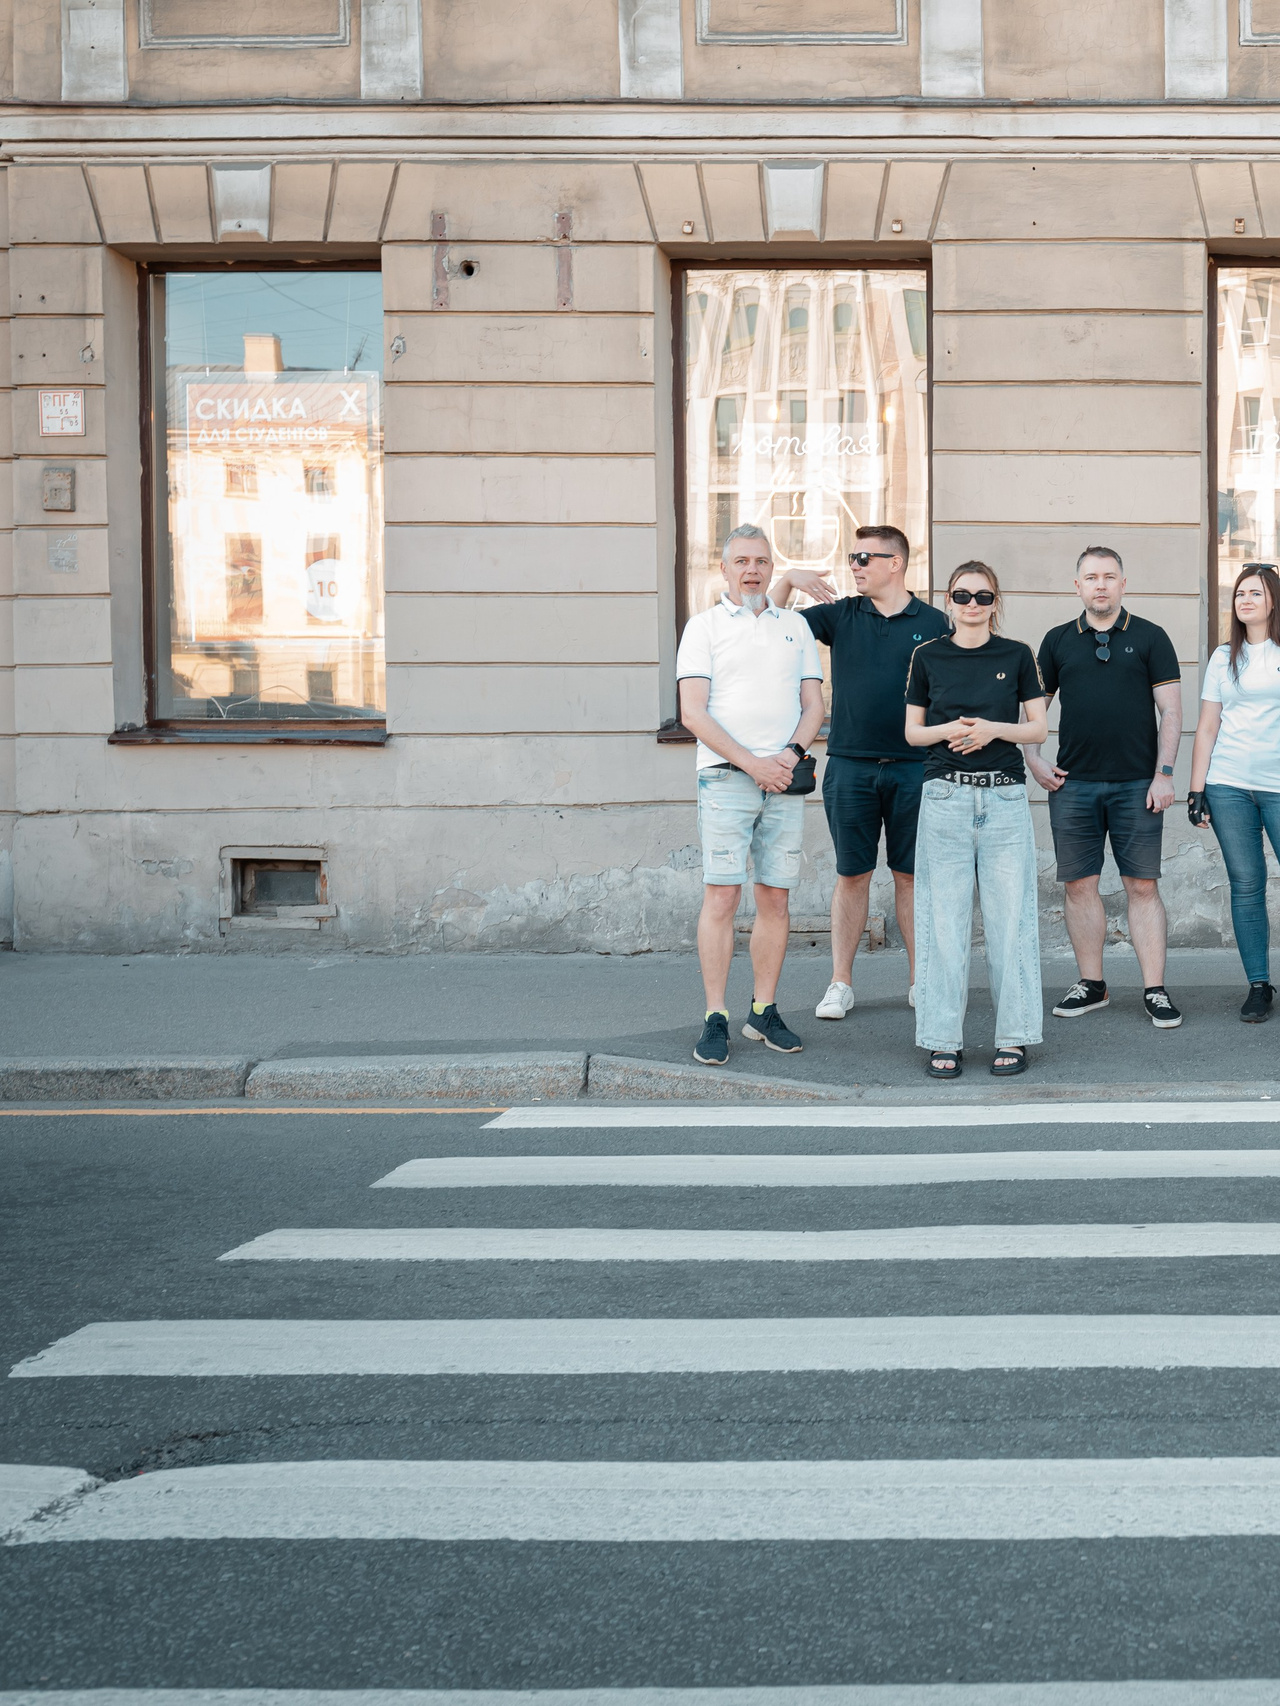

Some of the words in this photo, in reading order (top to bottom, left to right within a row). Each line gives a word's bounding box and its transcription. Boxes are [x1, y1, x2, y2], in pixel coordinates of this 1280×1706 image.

[52, 394, 70, 407] ПГ
[195, 397, 307, 422] СКИДКА
[197, 428, 231, 444] ДЛЯ
